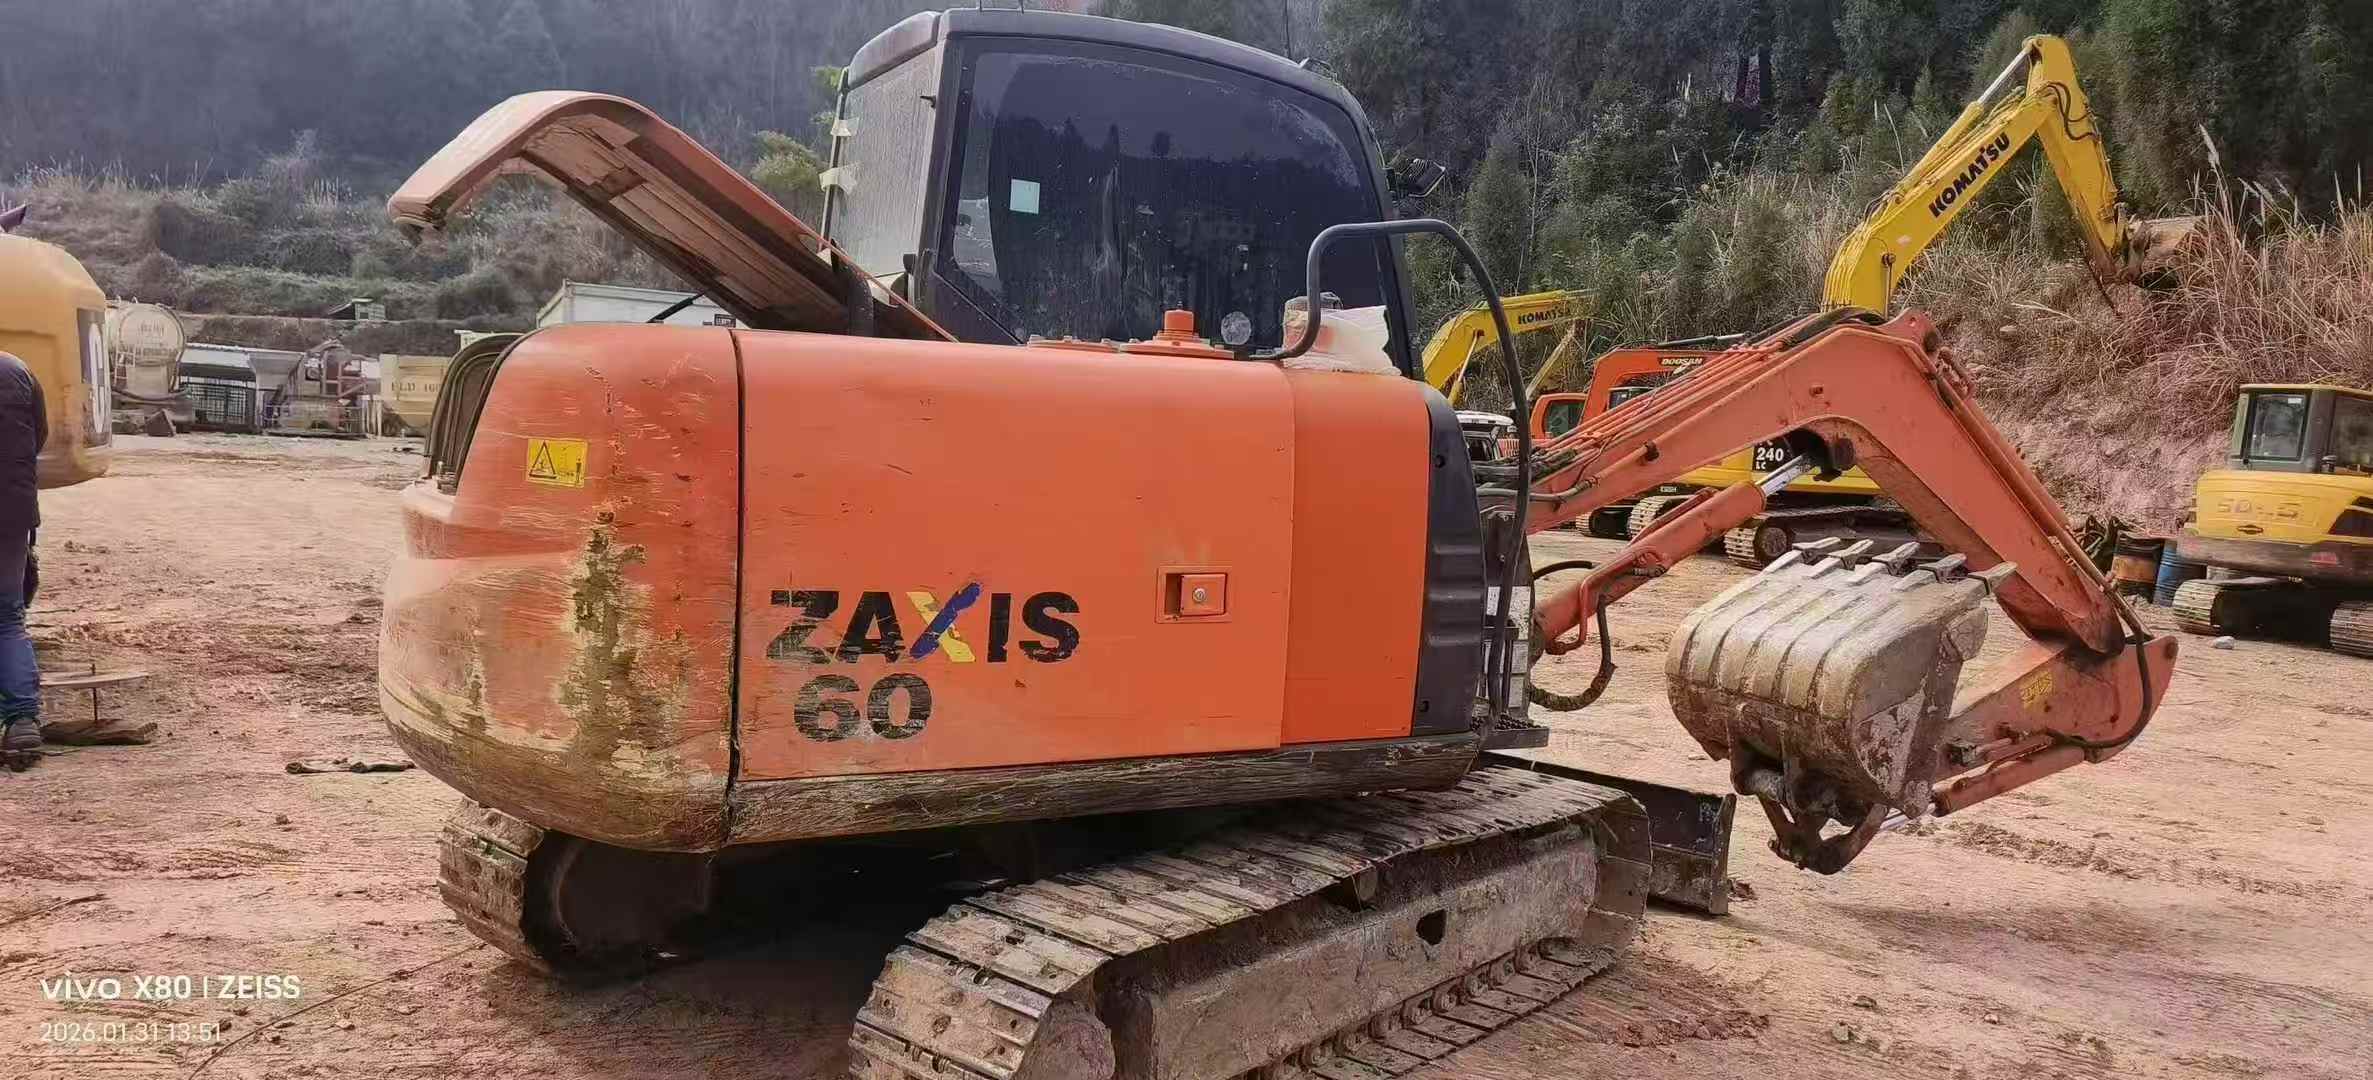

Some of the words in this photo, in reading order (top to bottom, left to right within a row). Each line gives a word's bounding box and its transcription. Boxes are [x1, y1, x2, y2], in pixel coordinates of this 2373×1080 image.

[1928, 132, 2010, 217] KOMATSU
[1661, 357, 1703, 367] DOOSAN
[1755, 461, 1767, 470] LC
[1756, 447, 1784, 461] 240
[767, 582, 1080, 664] ZAXIS
[794, 673, 933, 743] 60
